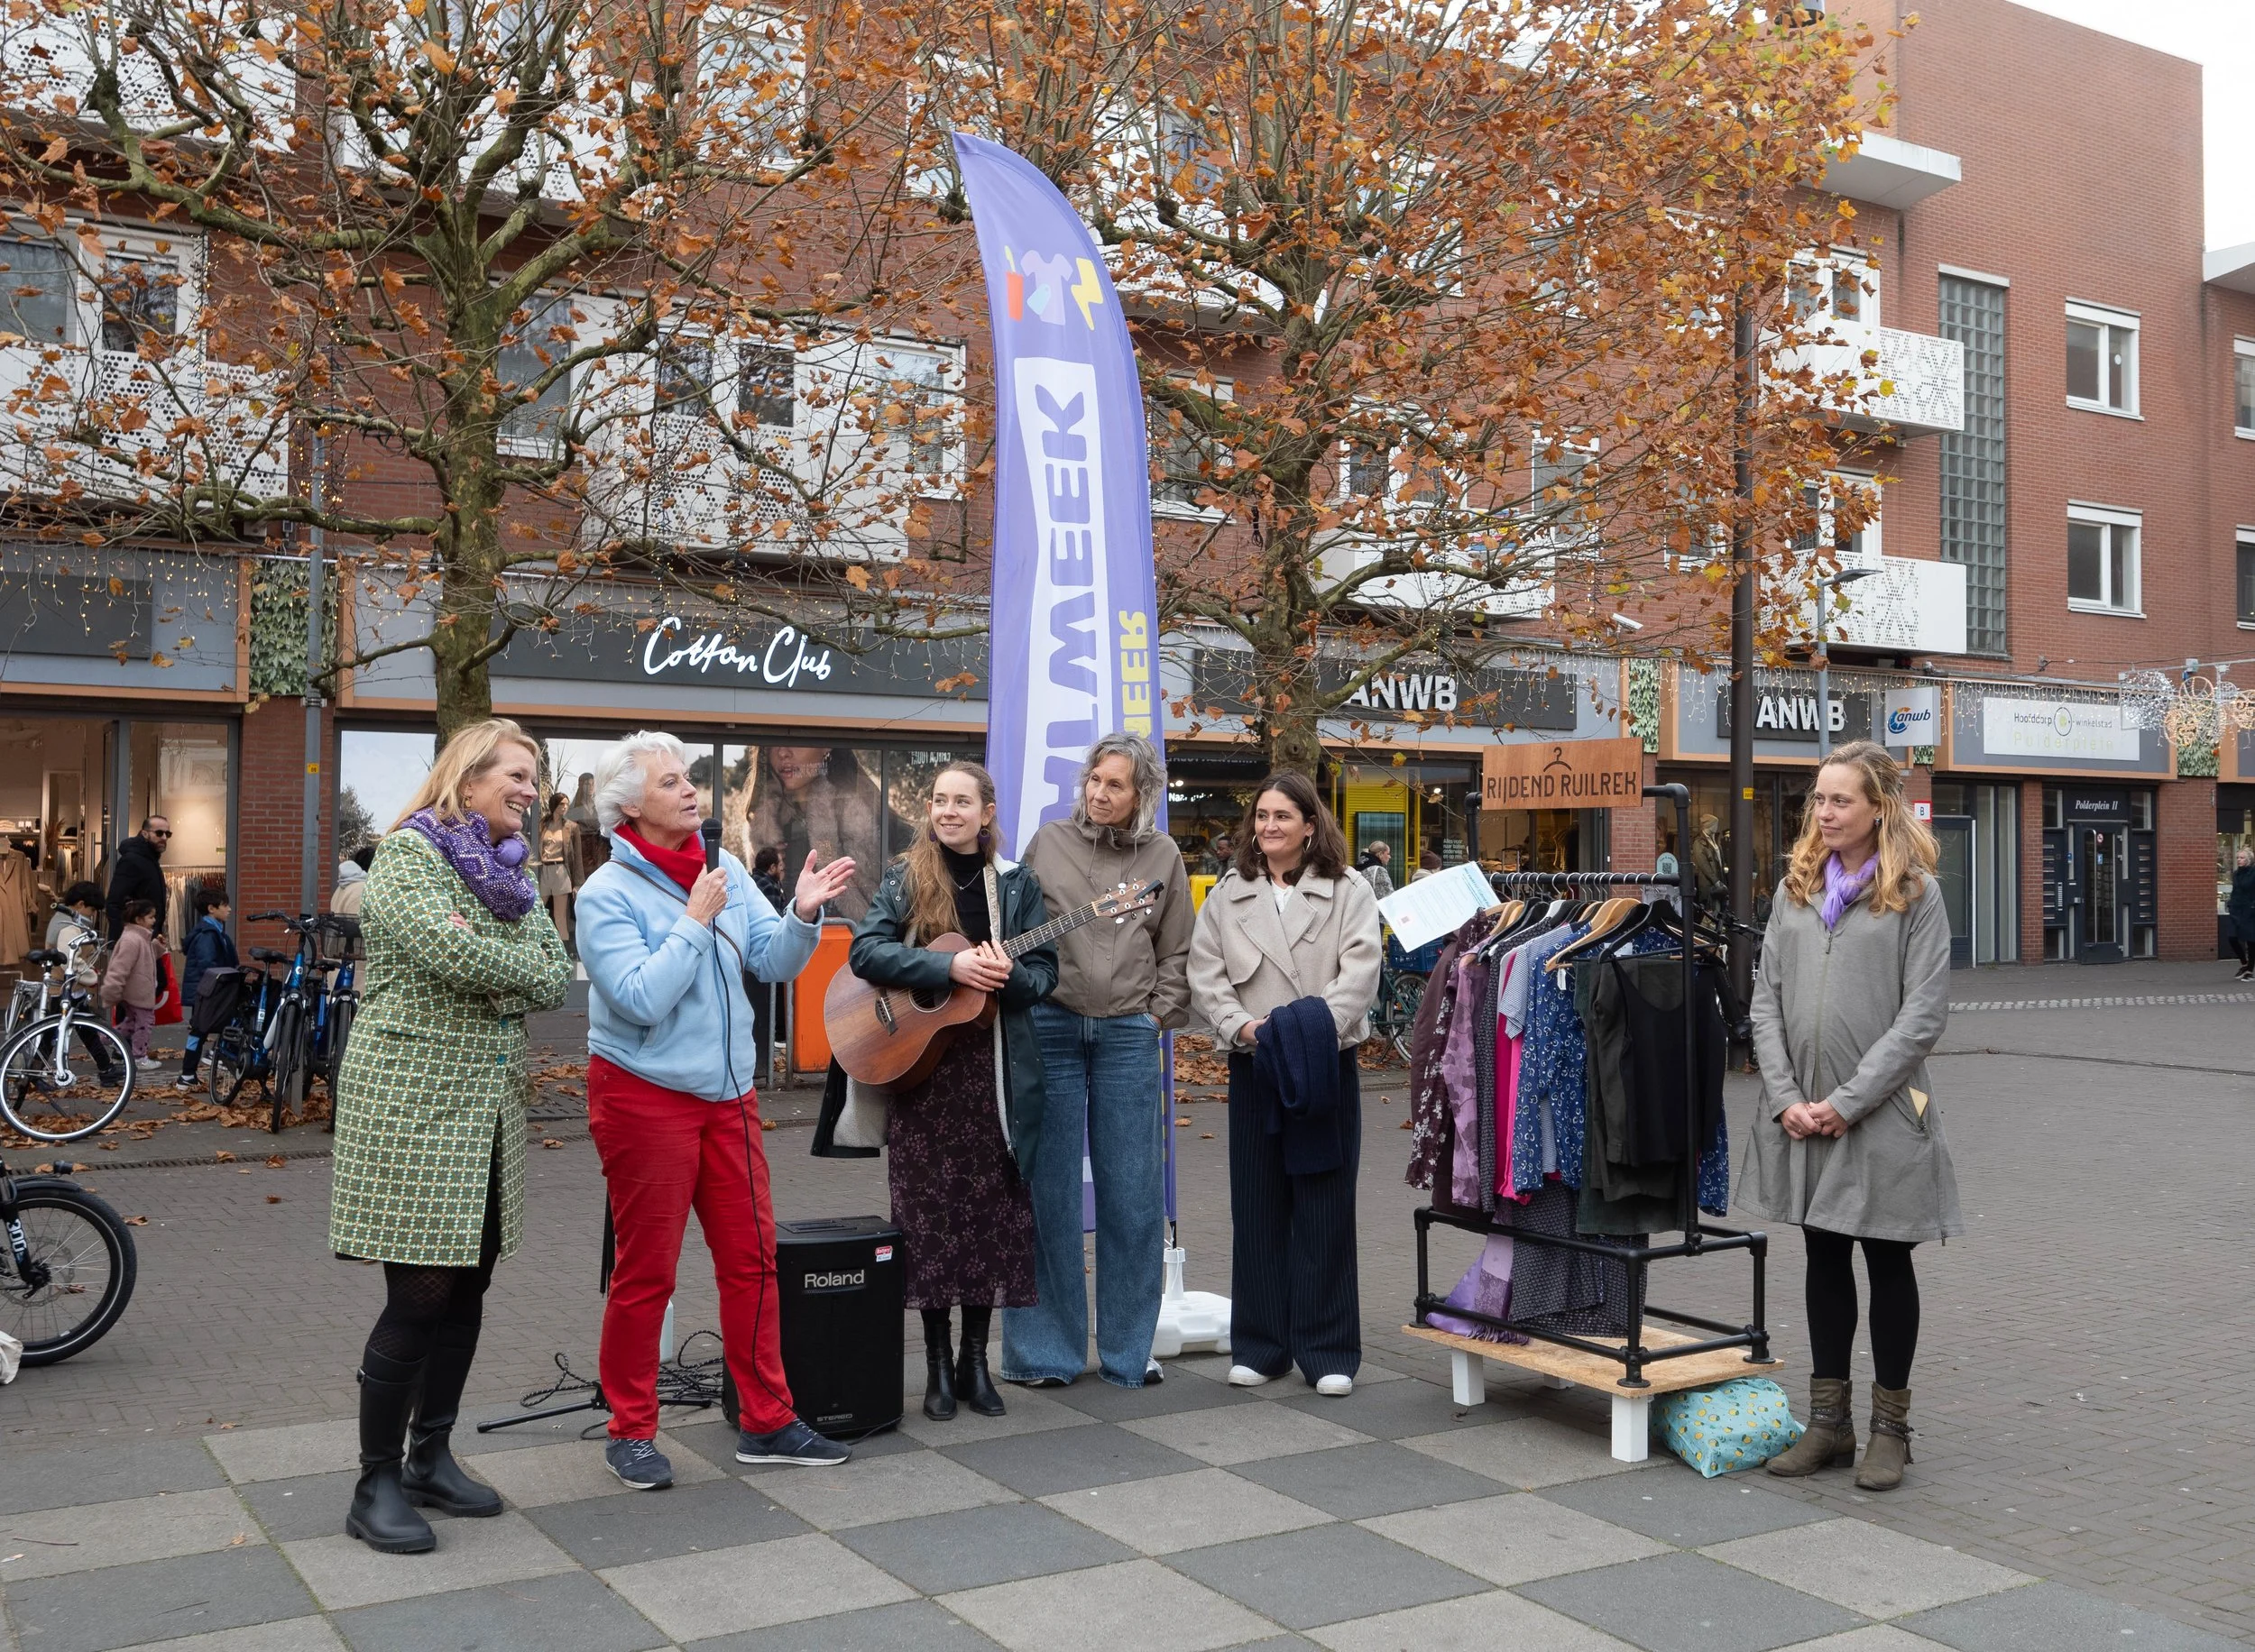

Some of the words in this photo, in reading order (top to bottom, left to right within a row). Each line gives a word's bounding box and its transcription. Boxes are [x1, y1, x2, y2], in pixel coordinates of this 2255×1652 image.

[643, 617, 758, 675] Cotton
[763, 626, 832, 688] Club
[1345, 670, 1458, 711] ANWB
[1756, 695, 1845, 731] ANWB
[1897, 709, 1931, 721] anwb
[1486, 774, 1555, 804] RIJDEND
[1560, 771, 1636, 797] RUILREK
[1919, 806, 1925, 816] B
[2076, 800, 2110, 812] Polderplein
[805, 1269, 865, 1289] Roland
